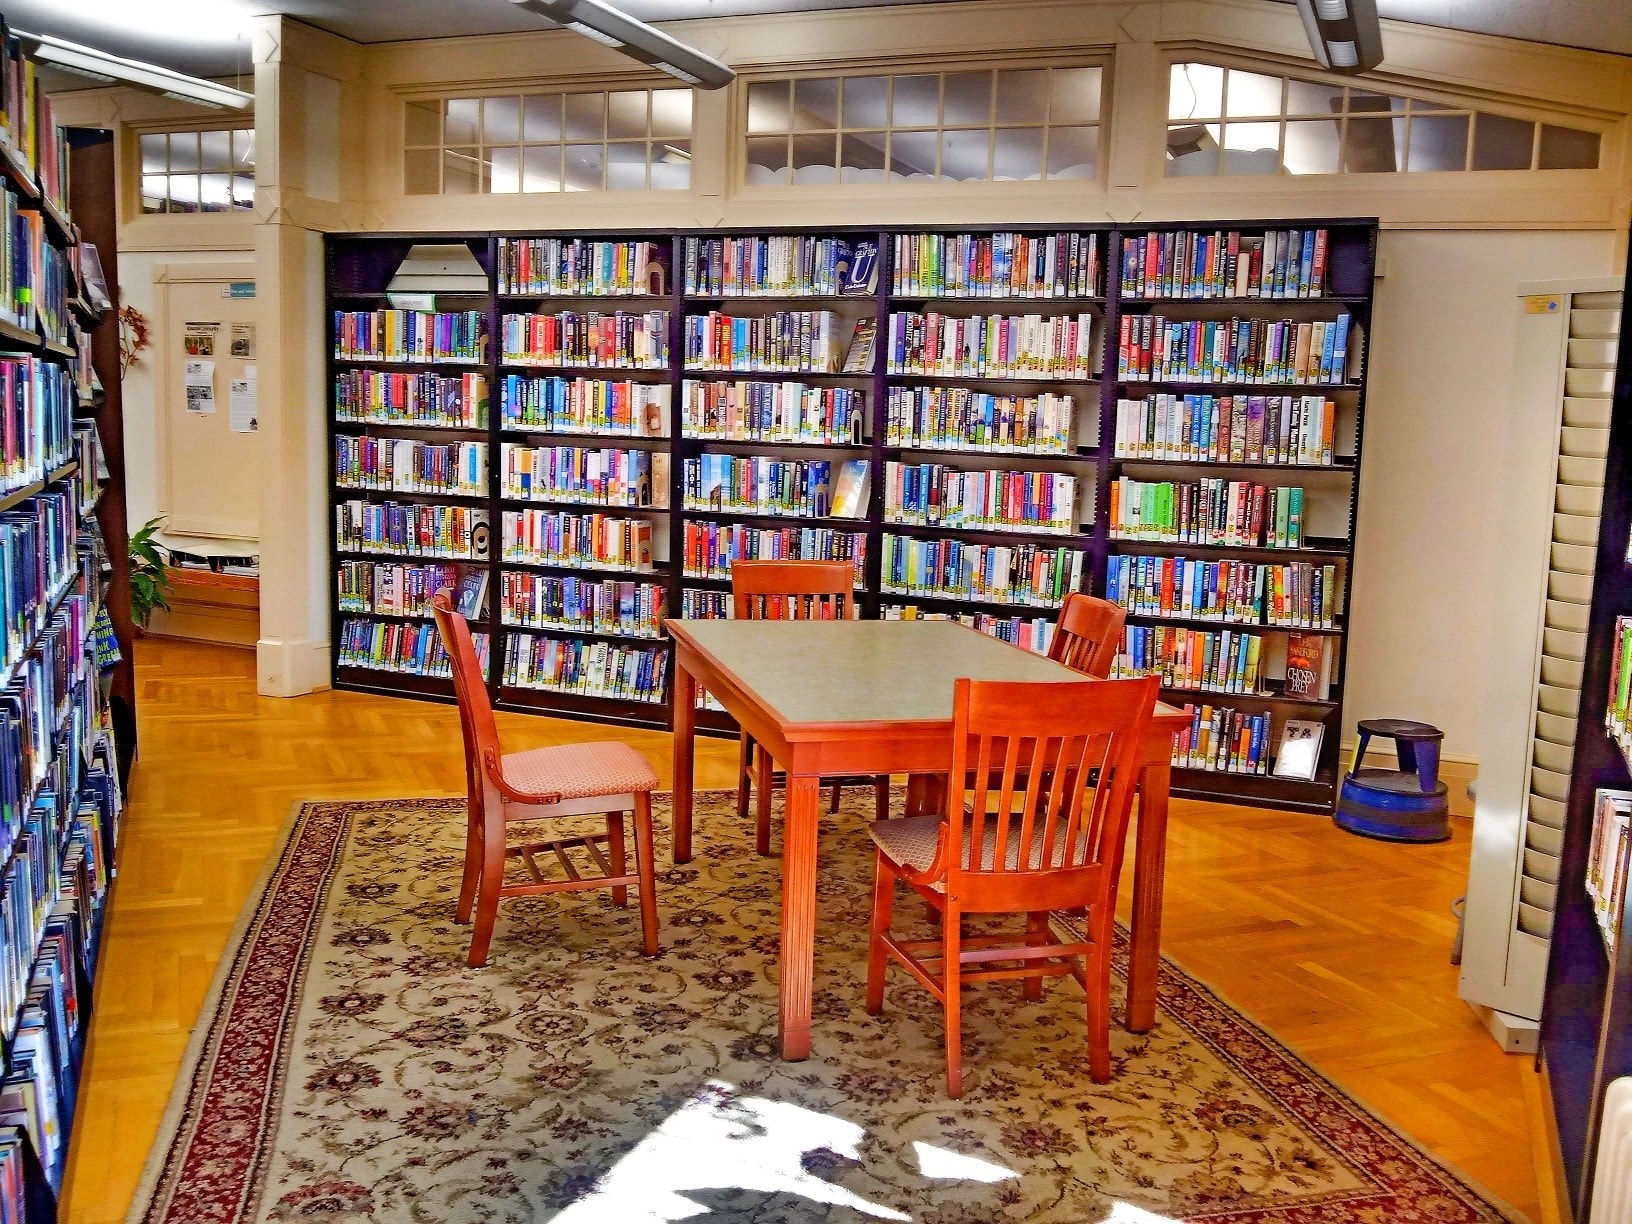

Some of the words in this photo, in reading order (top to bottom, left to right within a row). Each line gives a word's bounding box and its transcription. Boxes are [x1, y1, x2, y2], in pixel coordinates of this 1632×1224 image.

[851, 255, 873, 283] U
[1287, 667, 1317, 684] CHOSEN
[1290, 680, 1308, 694] PREY
